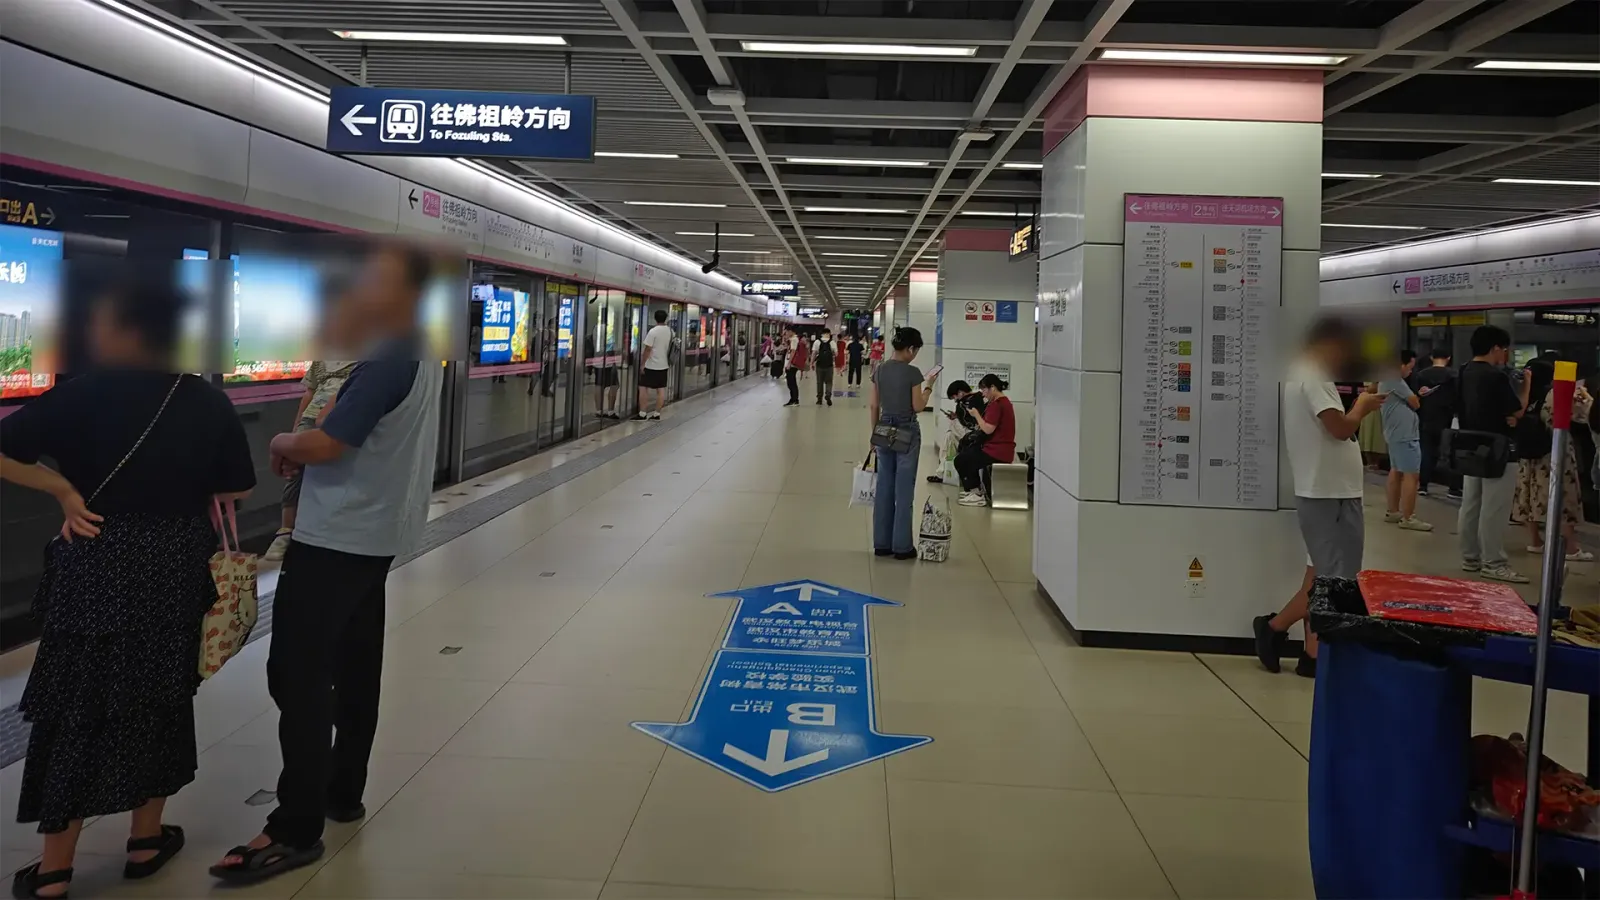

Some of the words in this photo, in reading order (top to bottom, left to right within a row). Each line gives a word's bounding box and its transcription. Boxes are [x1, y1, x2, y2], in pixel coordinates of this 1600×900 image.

[430, 102, 571, 130] 往佛祖岭方向
[430, 130, 443, 139] To
[445, 130, 490, 143] Fozuling
[492, 132, 512, 142] Sta.
[760, 602, 803, 615] A
[742, 617, 858, 628] 武汉教育电视台
[745, 671, 836, 683] 实验学校
[719, 679, 858, 694] 武汉市常青树
[730, 704, 773, 713] 出口
[786, 702, 836, 726] B
